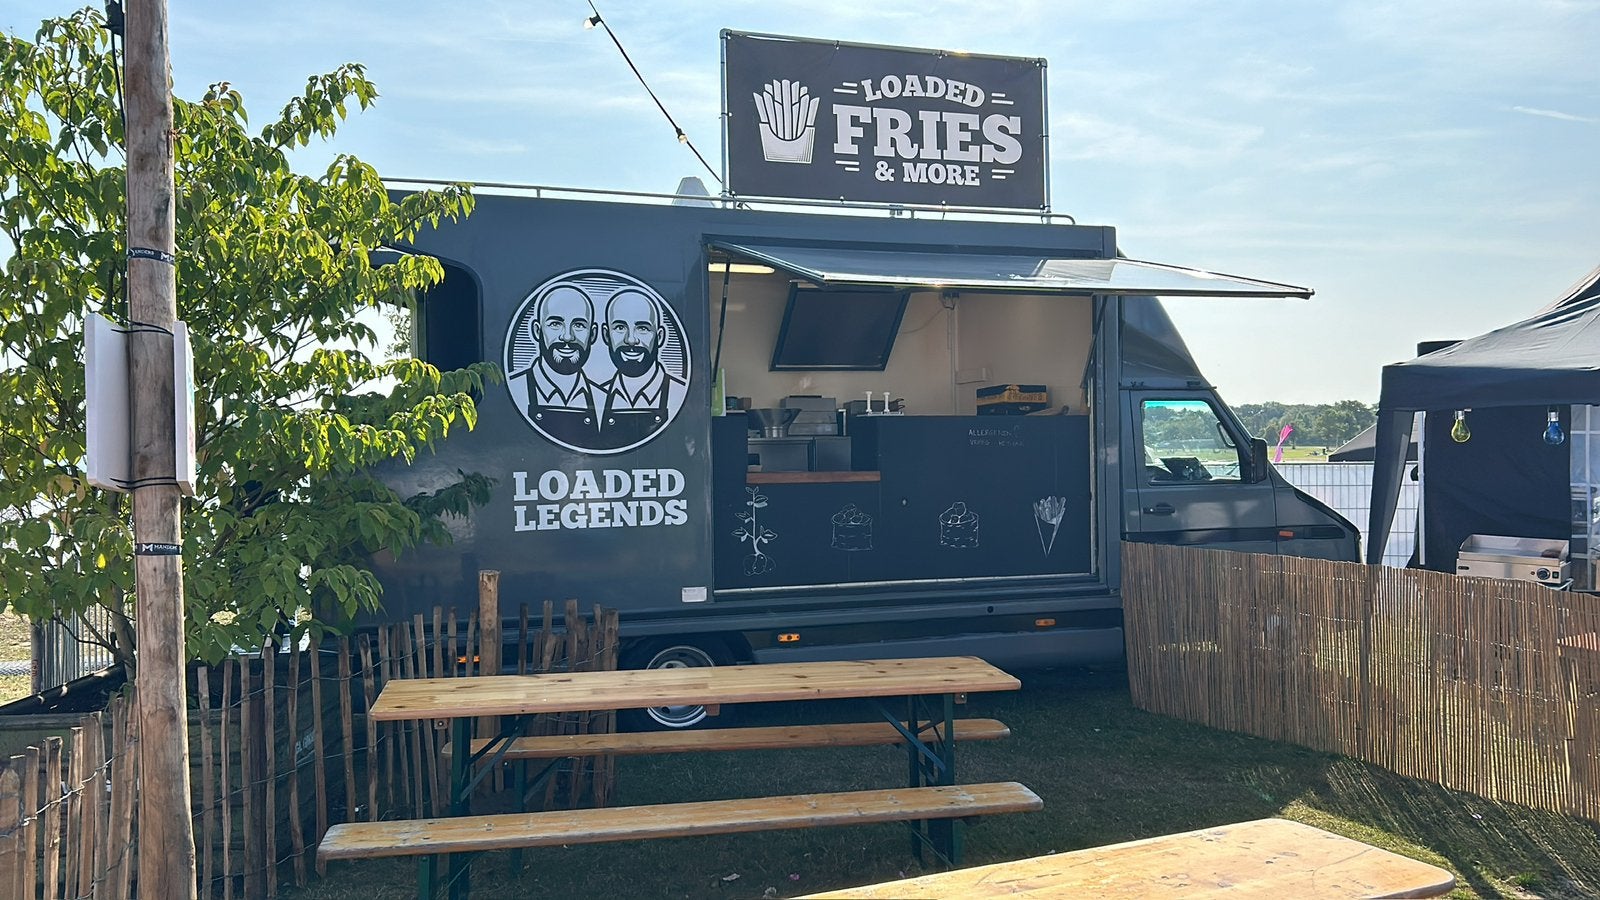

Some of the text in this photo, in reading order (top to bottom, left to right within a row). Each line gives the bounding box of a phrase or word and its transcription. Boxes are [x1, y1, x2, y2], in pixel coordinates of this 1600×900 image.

[861, 75, 985, 108] LOADED
[833, 105, 1022, 164] FRIES
[874, 161, 980, 186] & MORE
[514, 469, 685, 501] LOADED
[514, 500, 688, 531] LEGENDS
